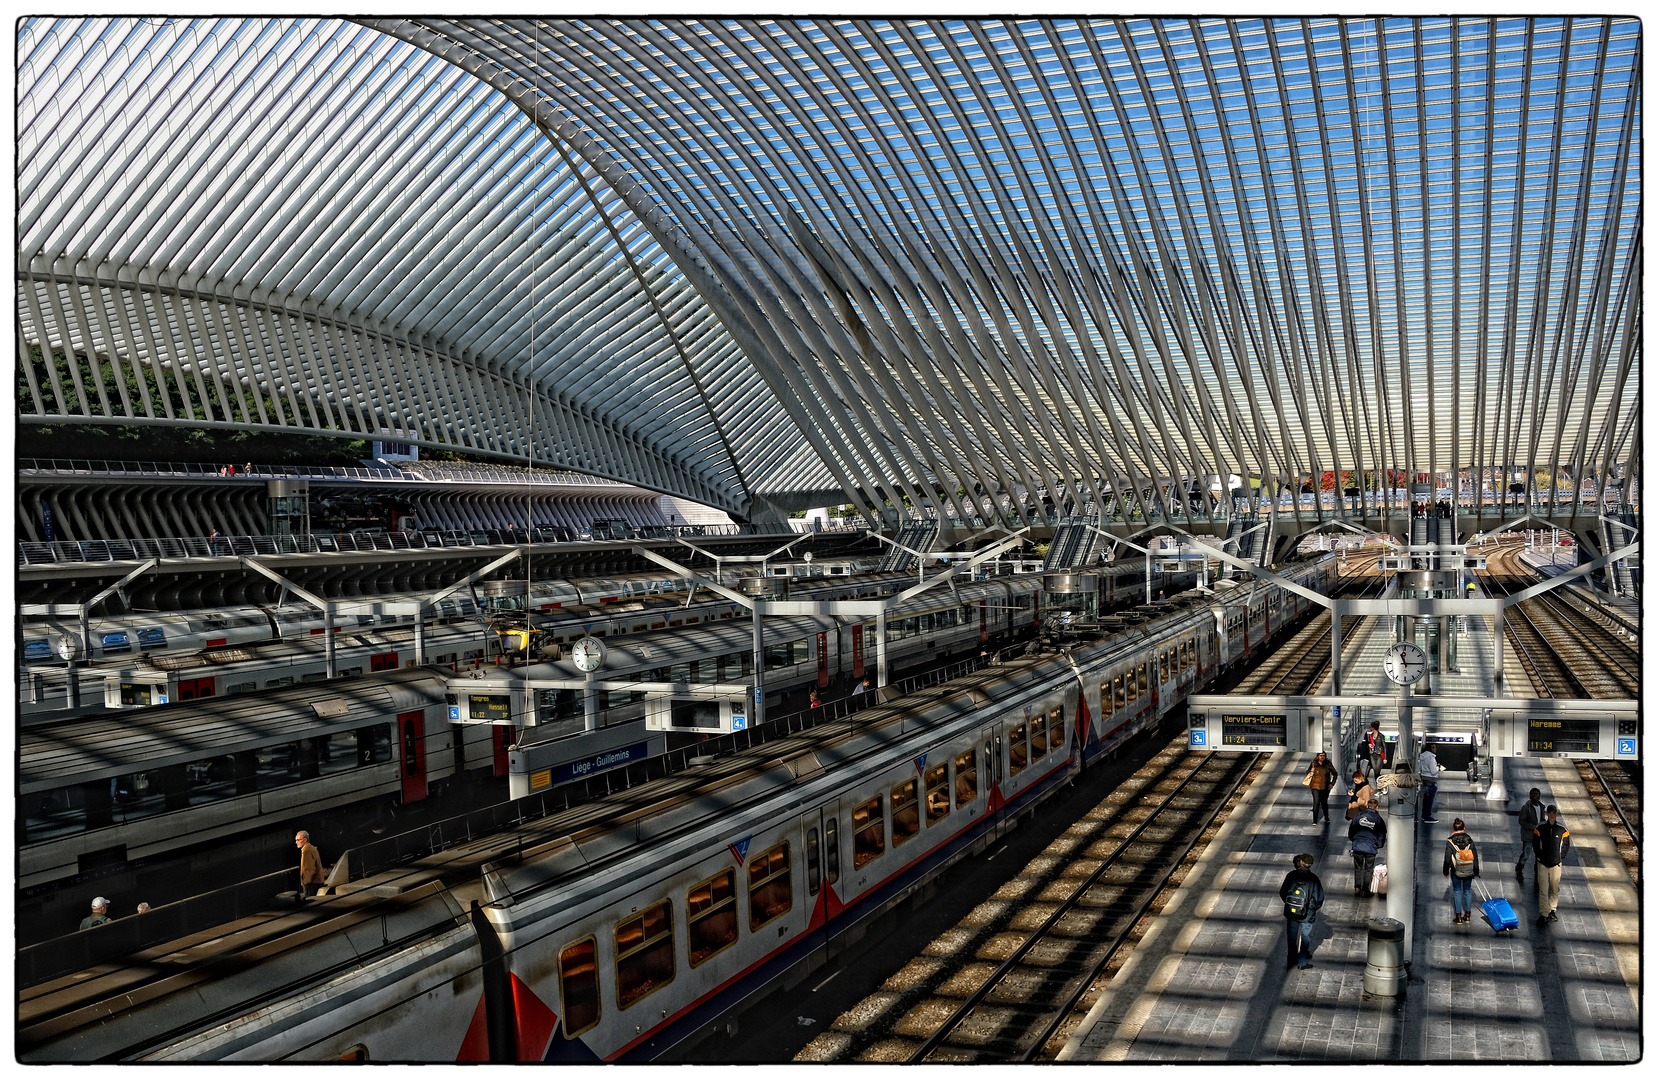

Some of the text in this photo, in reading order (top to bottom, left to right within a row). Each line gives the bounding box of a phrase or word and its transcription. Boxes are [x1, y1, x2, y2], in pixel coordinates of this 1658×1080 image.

[1224, 716, 1281, 724] Verviers-Centr
[1225, 736, 1245, 744] 11:24
[1530, 742, 1553, 750] 11:34
[365, 750, 370, 761] 2
[572, 761, 591, 775] Liège
[596, 750, 630, 767] Guillemins
[741, 842, 746, 854] 2
